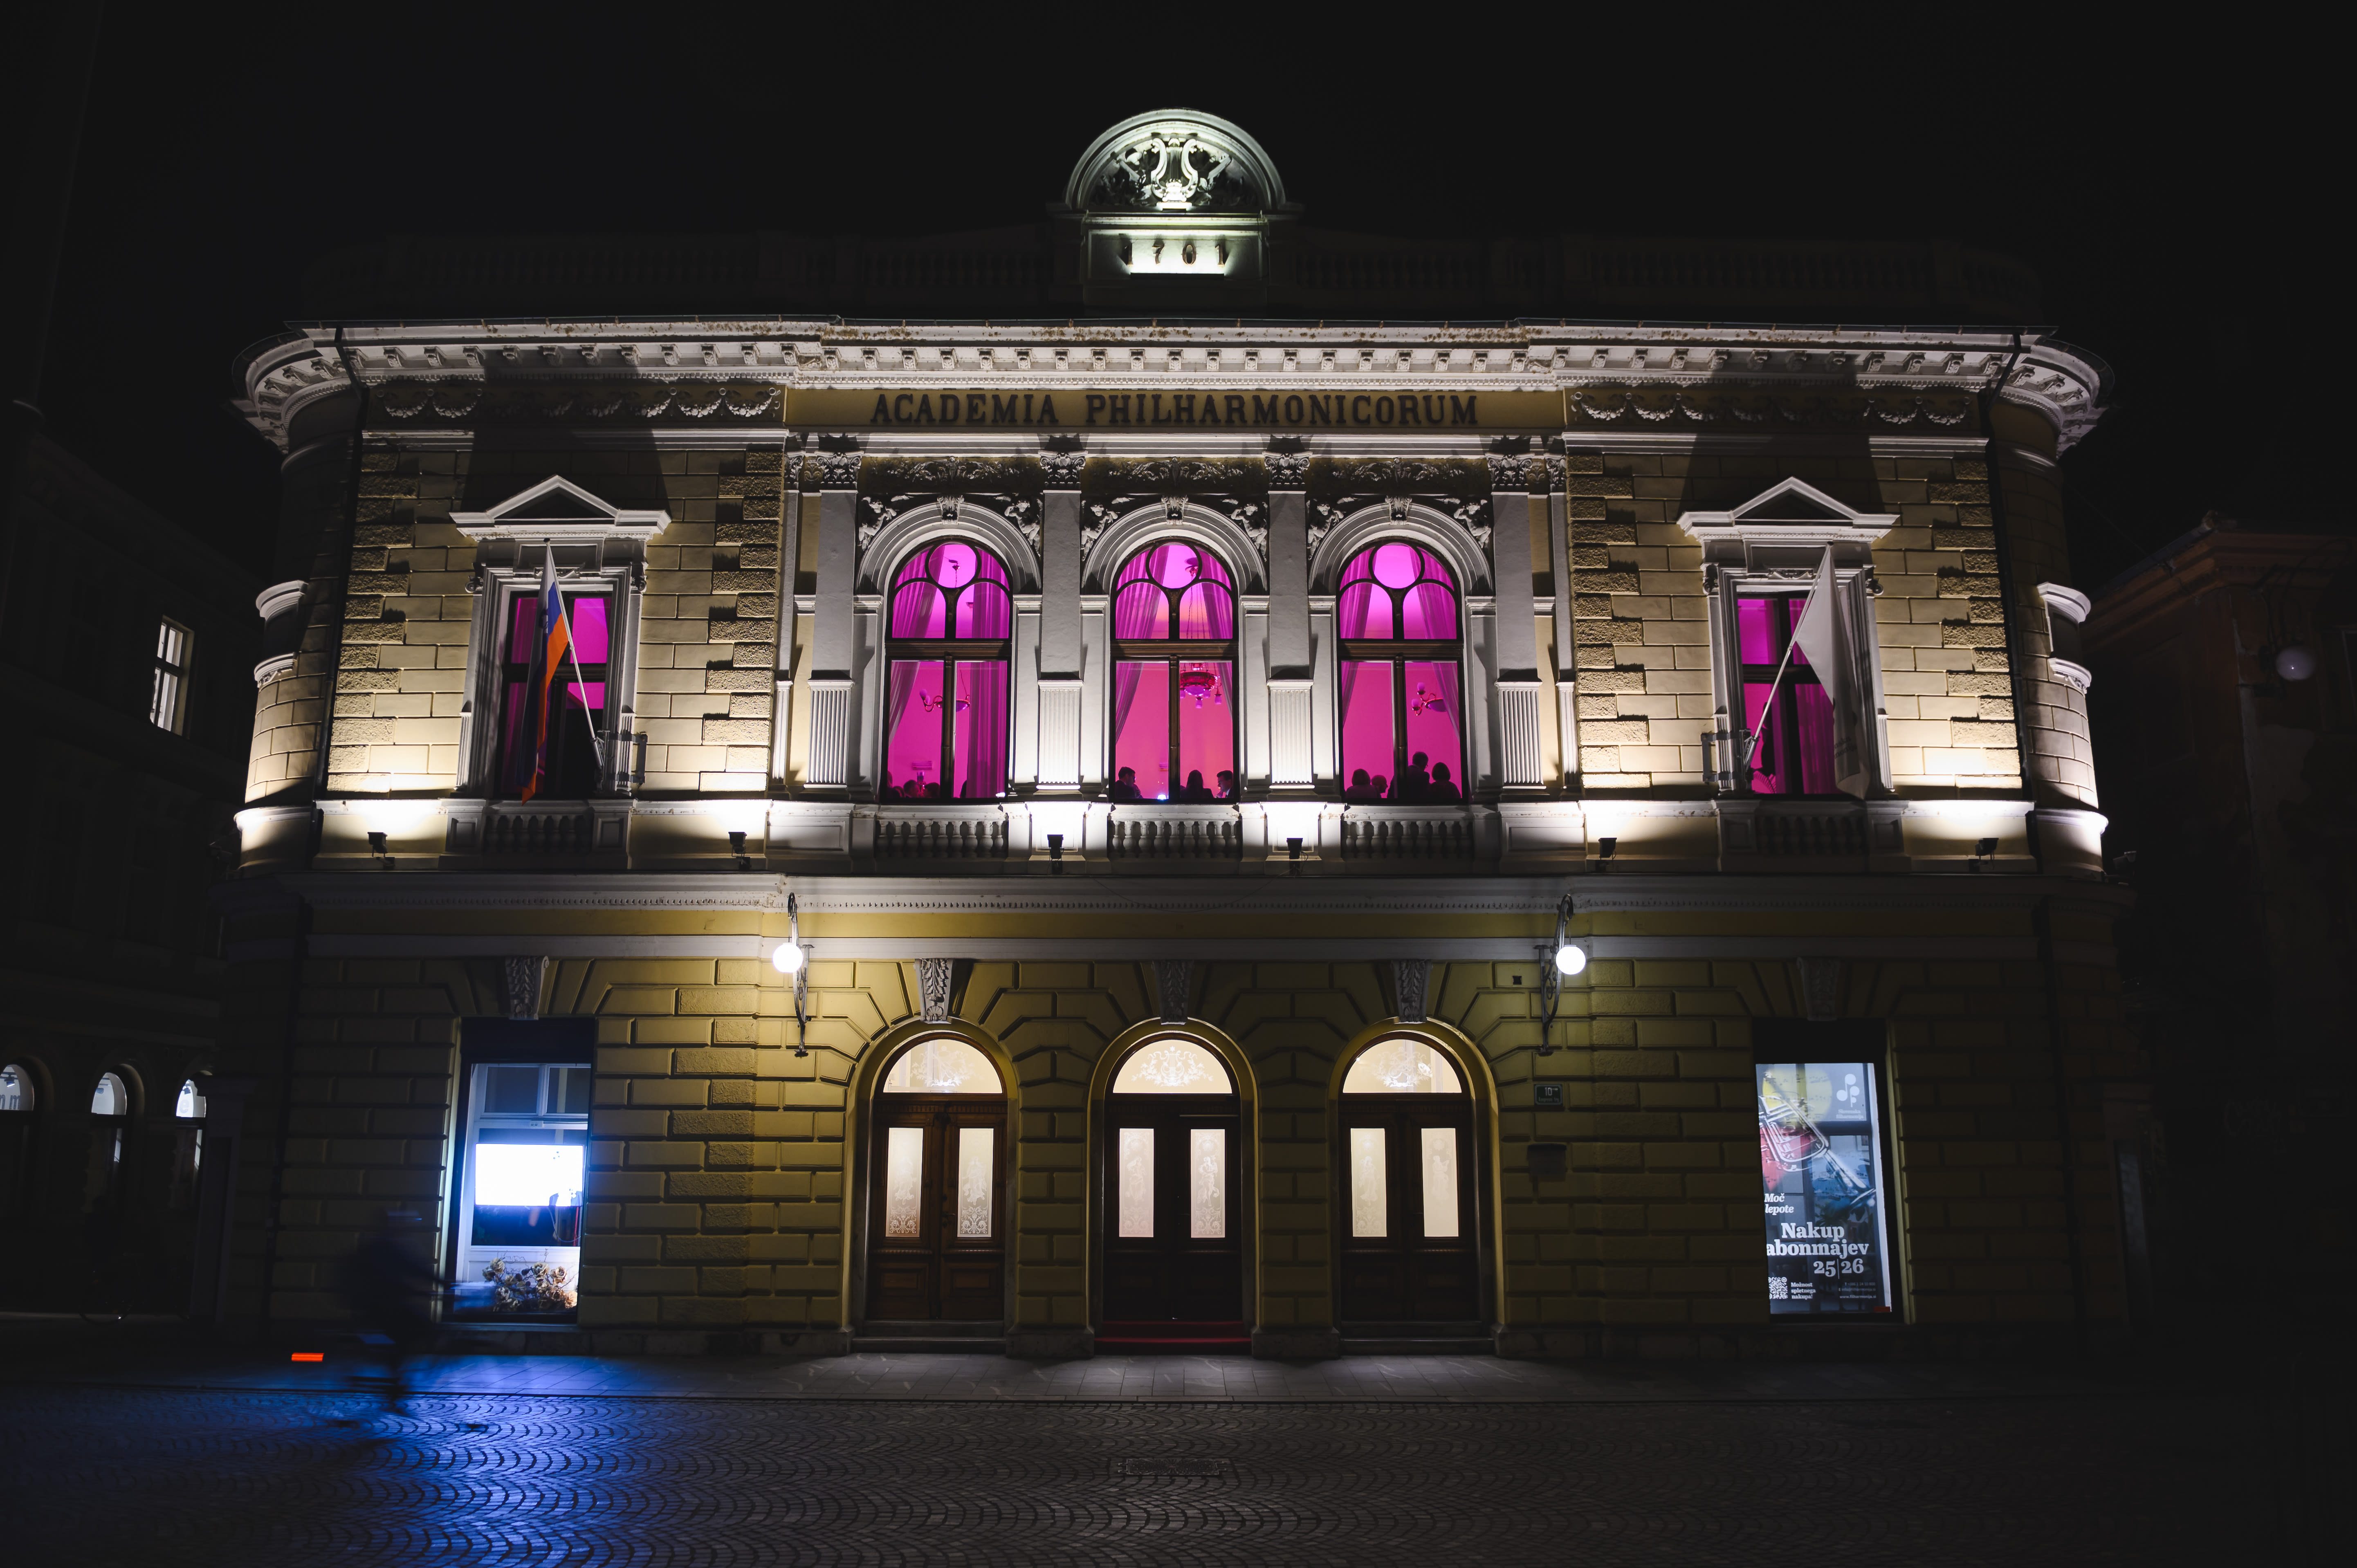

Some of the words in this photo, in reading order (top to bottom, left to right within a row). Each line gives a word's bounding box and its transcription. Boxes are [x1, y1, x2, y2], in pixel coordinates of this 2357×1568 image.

[870, 393, 1059, 423] ACADEMIA
[1086, 394, 1478, 424] PHILHARMONICORUM
[1545, 1087, 1552, 1096] 10
[1764, 1193, 1785, 1202] Moč
[1765, 1204, 1794, 1215] lepote
[1780, 1221, 1845, 1242] Nakup
[1767, 1239, 1869, 1259] abonmajev
